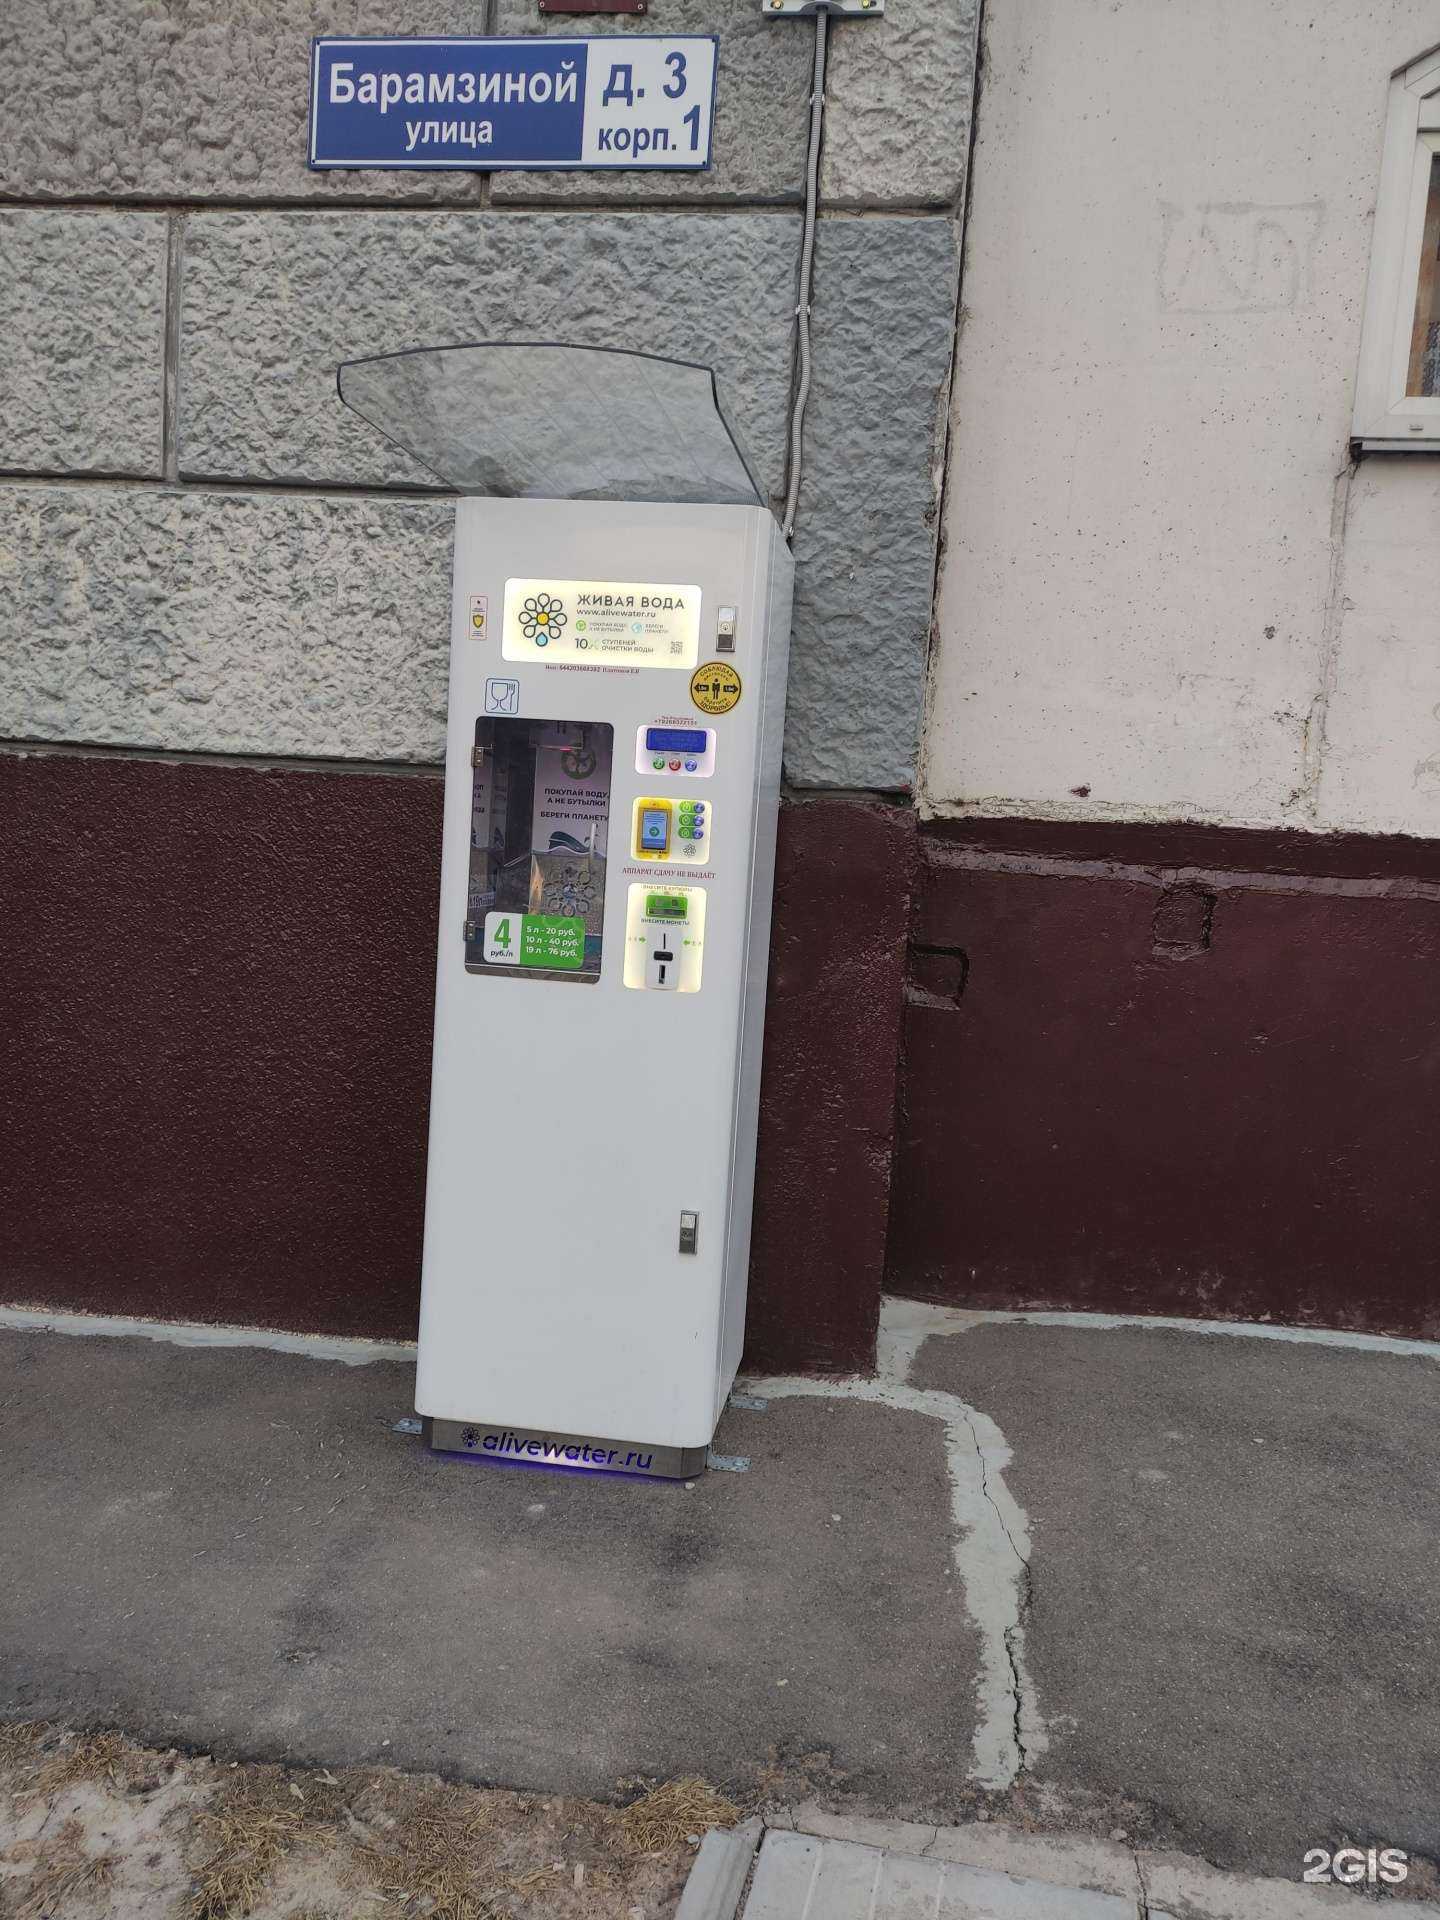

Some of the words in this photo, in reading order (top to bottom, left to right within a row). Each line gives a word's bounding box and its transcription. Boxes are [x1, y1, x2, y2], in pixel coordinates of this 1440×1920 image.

[602, 64, 645, 107] д.
[663, 51, 687, 99] 3
[329, 60, 578, 114] Барамзиной
[405, 119, 493, 151] улица
[577, 593, 634, 607] ЖИВАЯ
[641, 596, 685, 610] ВОДА
[576, 608, 656, 618] www.alivewater.ru
[544, 788, 584, 797] ПОКУПАЙ
[568, 799, 606, 807] БУТЫЛКИ
[541, 811, 570, 819] БЕРЕГИ
[622, 867, 652, 876] АППАРАТ
[654, 869, 676, 878] СДАЧУ
[494, 919, 511, 948] 4
[560, 949, 578, 957] руб.
[482, 1430, 655, 1469] alivewater.ru
